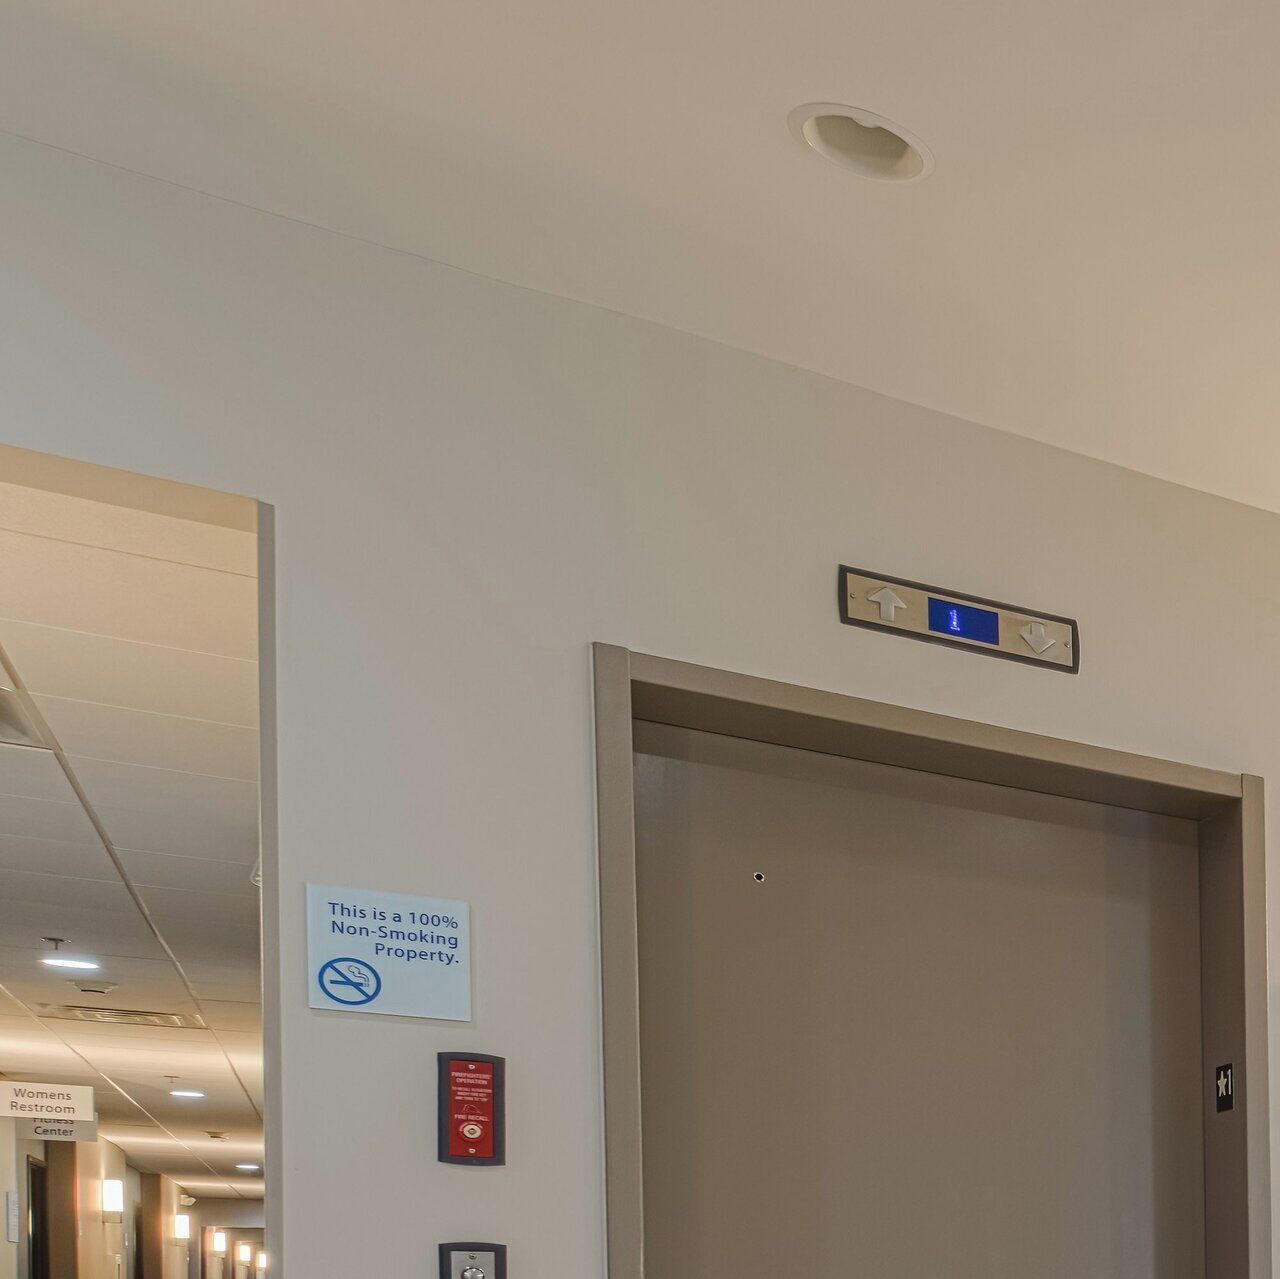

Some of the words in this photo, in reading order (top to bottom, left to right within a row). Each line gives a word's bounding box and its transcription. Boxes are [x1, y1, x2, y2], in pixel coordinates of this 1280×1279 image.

[328, 901, 367, 919] This
[373, 907, 387, 921] is
[392, 912, 402, 923] a
[409, 912, 459, 929] 100%
[331, 921, 459, 949] Non-Smoking
[375, 942, 459, 966] Property.
[13, 1088, 72, 1100] Womens
[10, 1101, 75, 1114] Restroom
[34, 1126, 74, 1136] Center
